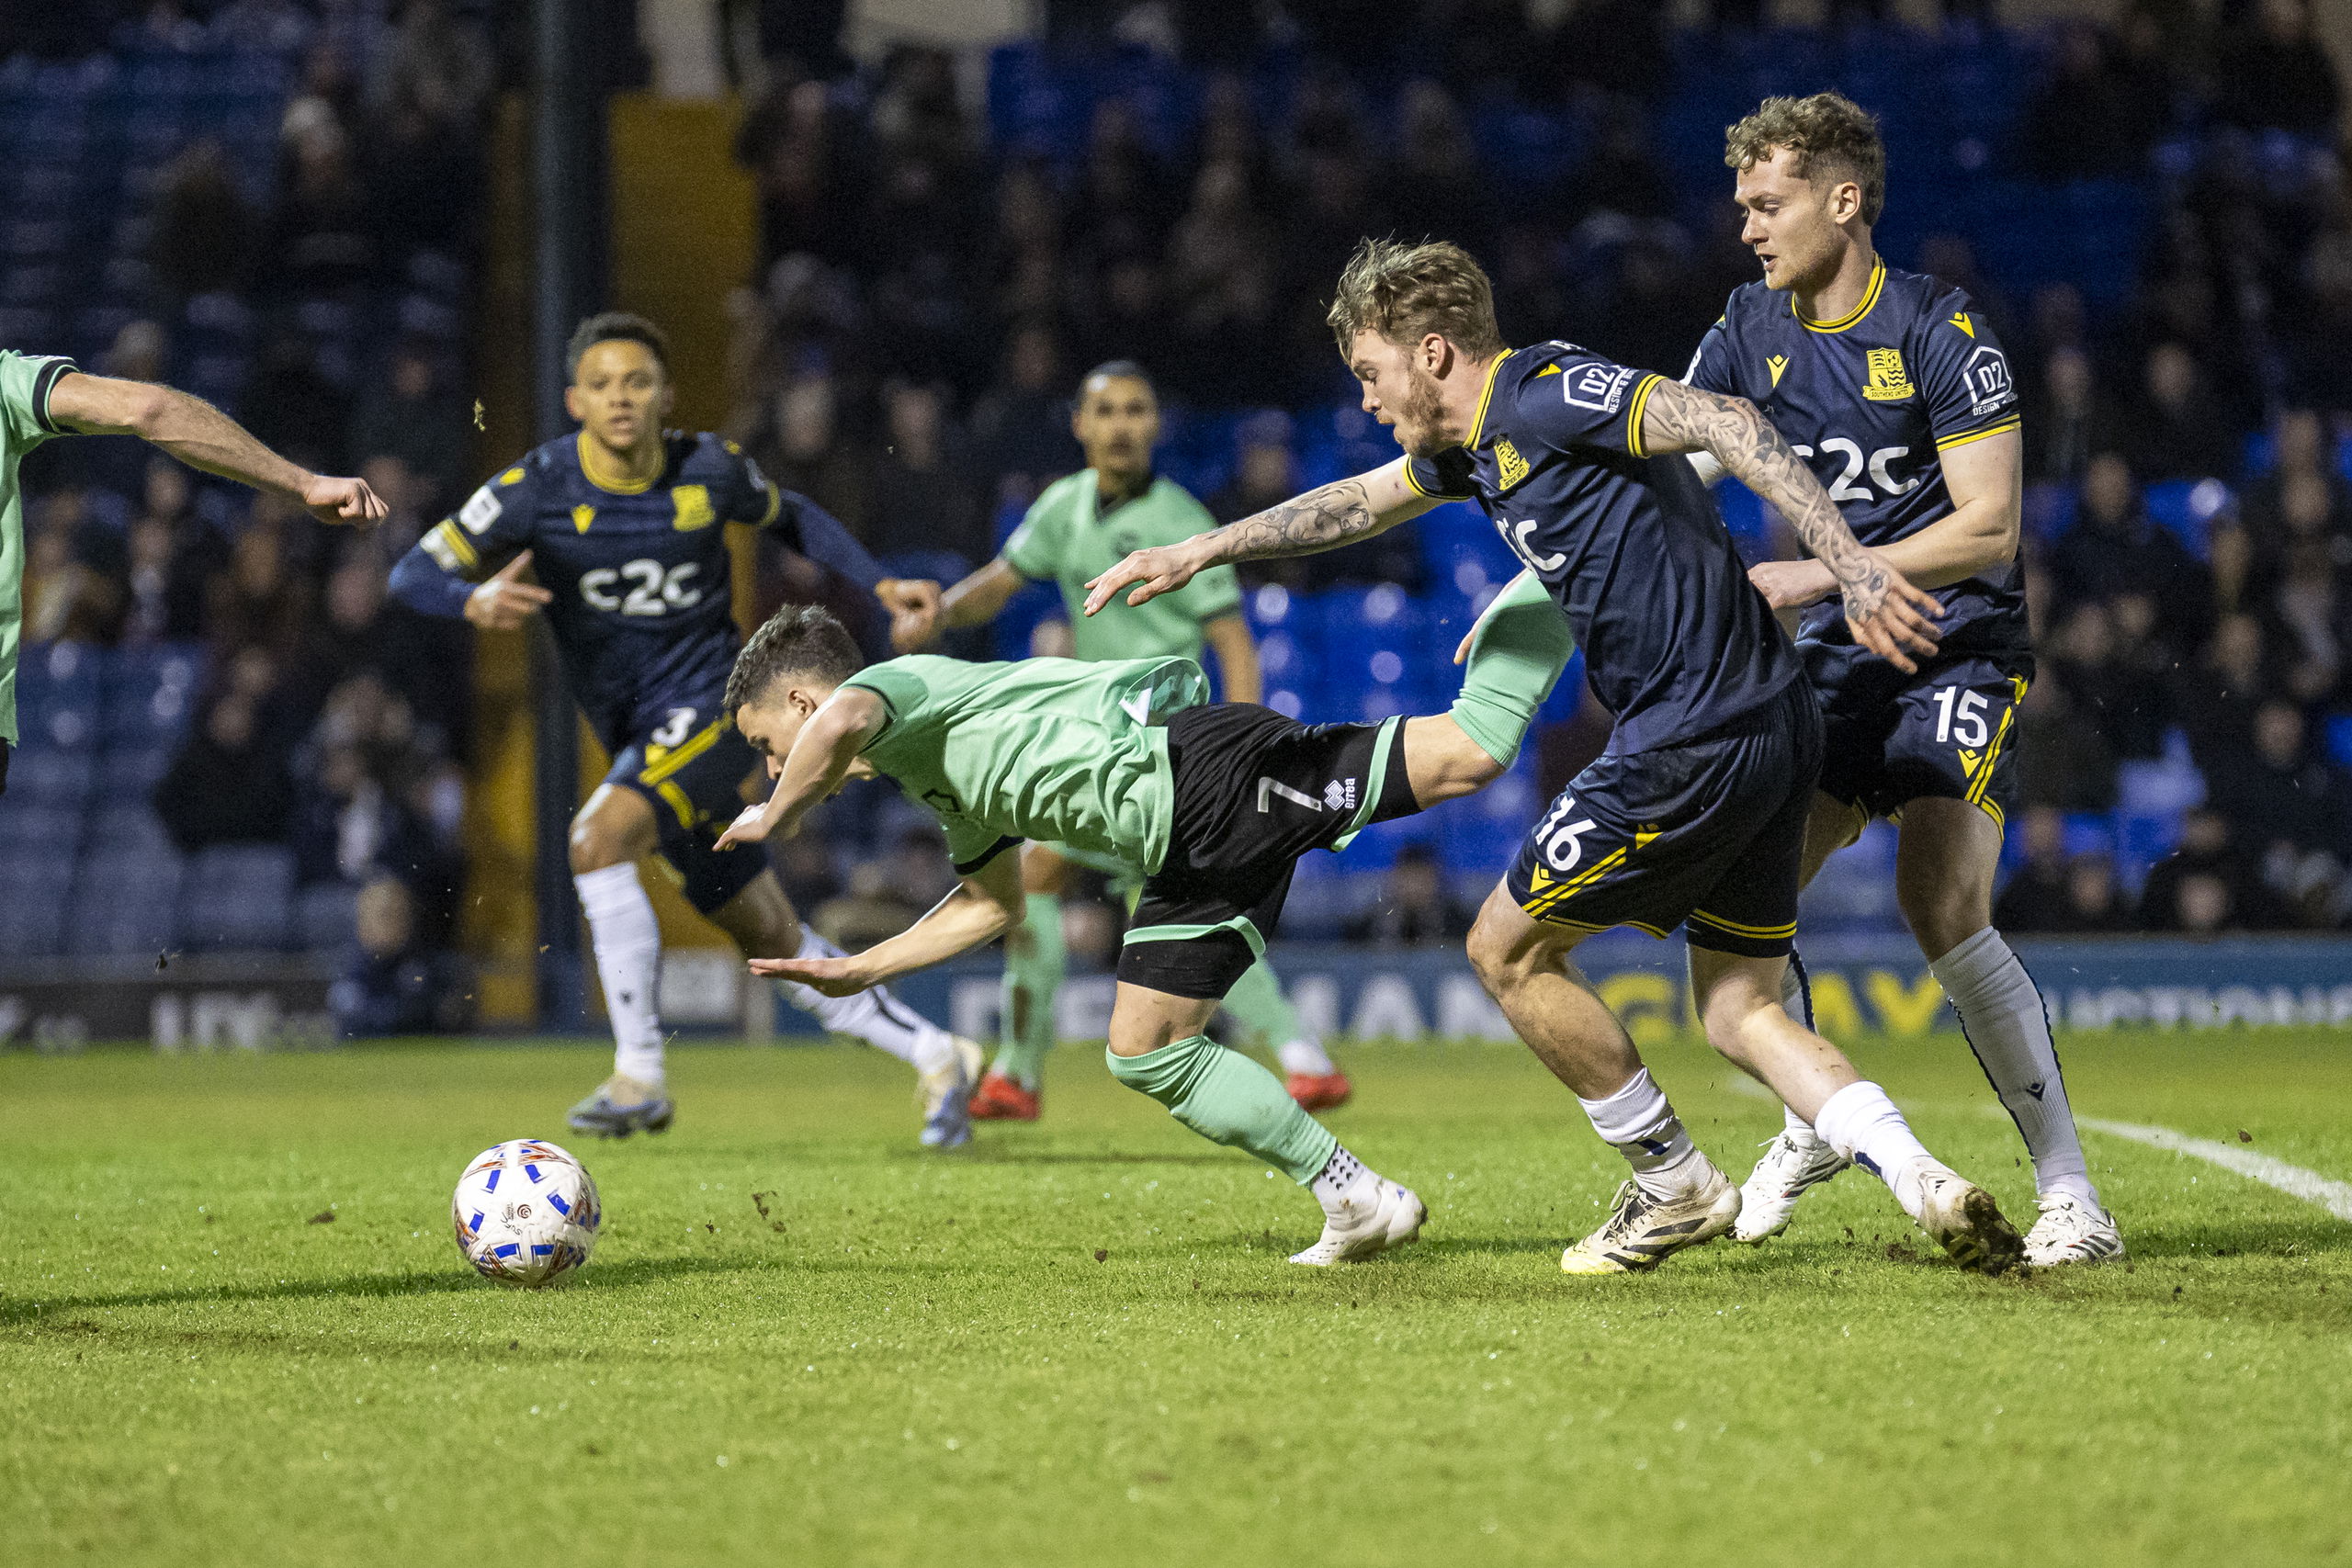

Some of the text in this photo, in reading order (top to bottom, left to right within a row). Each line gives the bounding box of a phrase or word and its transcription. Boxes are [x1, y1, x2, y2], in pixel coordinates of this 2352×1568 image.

[1578, 367, 1615, 395] D2
[1977, 361, 2007, 393] D2
[1973, 401, 2000, 416] DESIGN
[1792, 437, 1919, 502] 2c
[650, 706, 697, 748] 3
[1933, 685, 1988, 747] 15
[1257, 776, 1322, 814] 7
[1535, 795, 1597, 872] 16
